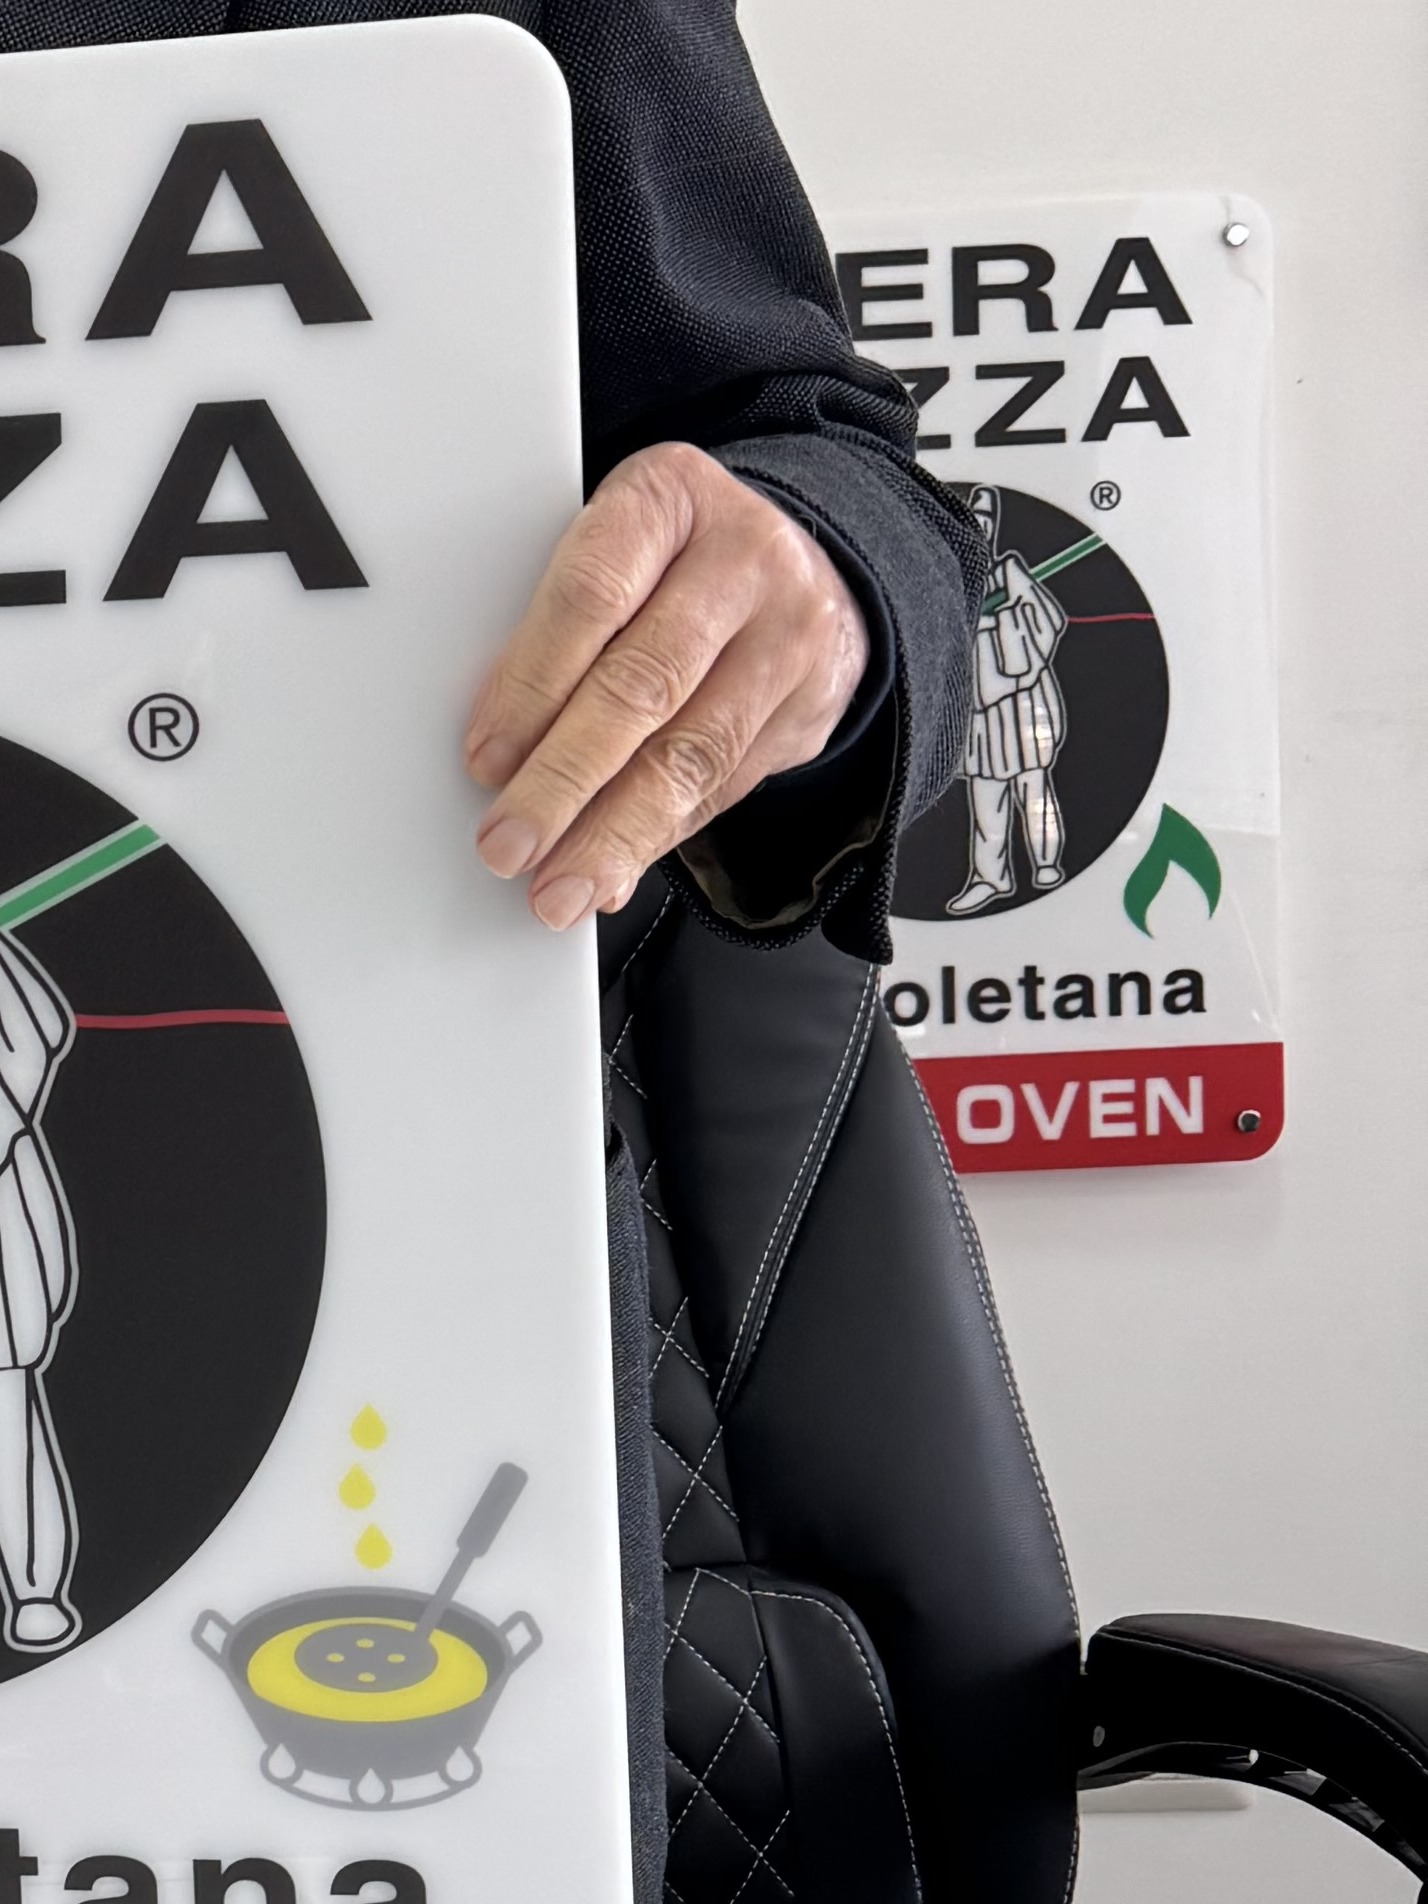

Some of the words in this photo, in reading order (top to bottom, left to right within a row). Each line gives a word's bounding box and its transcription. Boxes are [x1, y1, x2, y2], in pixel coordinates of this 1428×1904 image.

[835, 237, 1193, 341] ERA
[883, 964, 1206, 1027] oletana
[956, 1076, 1204, 1144] OVEN
